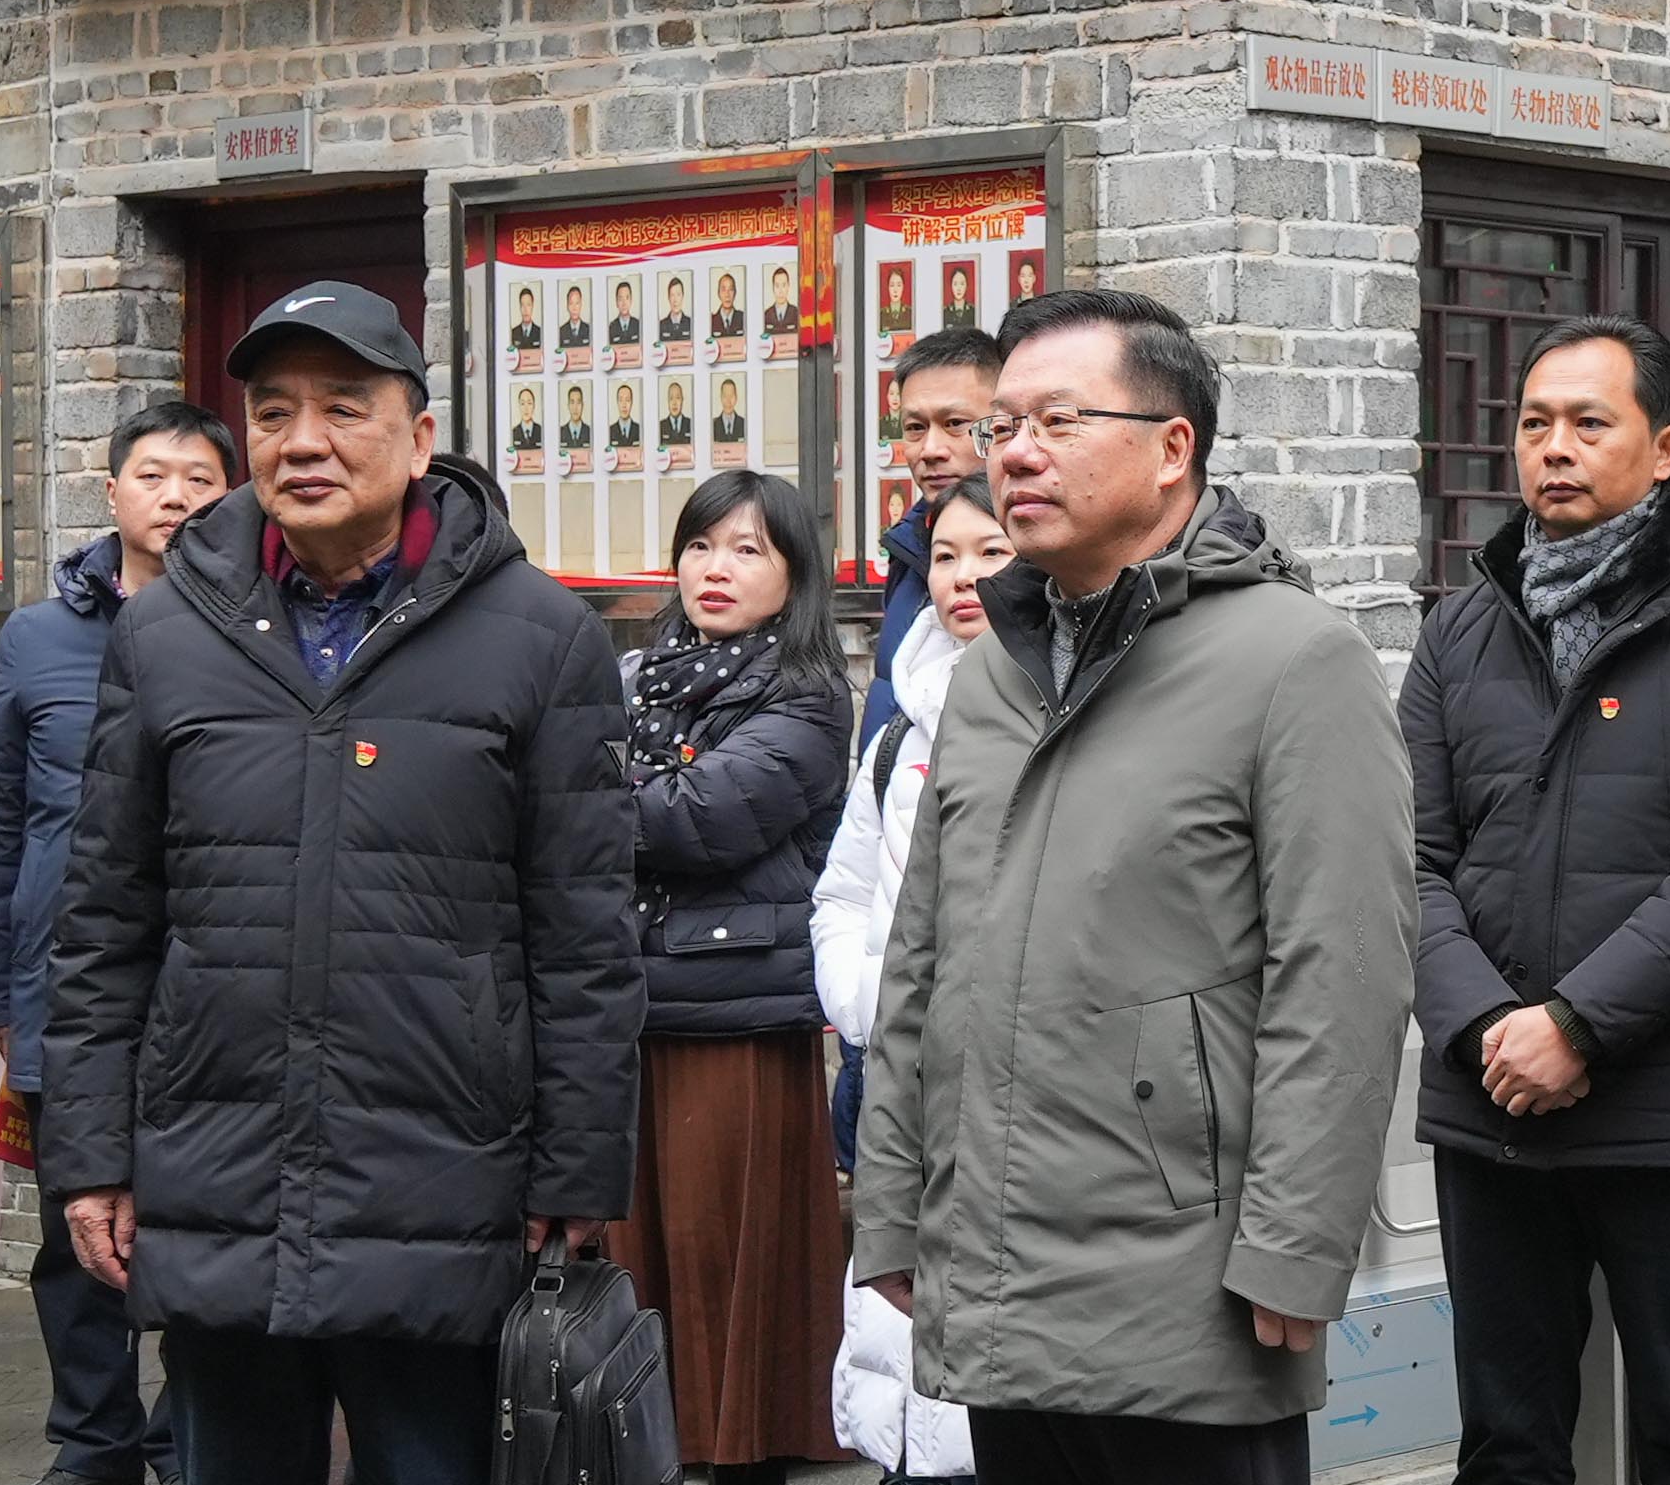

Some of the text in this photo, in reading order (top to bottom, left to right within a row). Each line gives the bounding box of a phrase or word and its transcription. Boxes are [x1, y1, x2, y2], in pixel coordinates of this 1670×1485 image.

[1264, 54, 1367, 101] 观众物品存放处
[1391, 69, 1488, 116] 轮椅领取处
[1511, 85, 1602, 131] 失物招领处
[225, 124, 299, 162] 安保值班室
[891, 176, 1037, 213] 黎平会议纪念馆
[512, 206, 798, 256] 黎平会议纪念馆安全保卫部岗位牌
[901, 209, 1027, 247] 讲解员岗位牌
